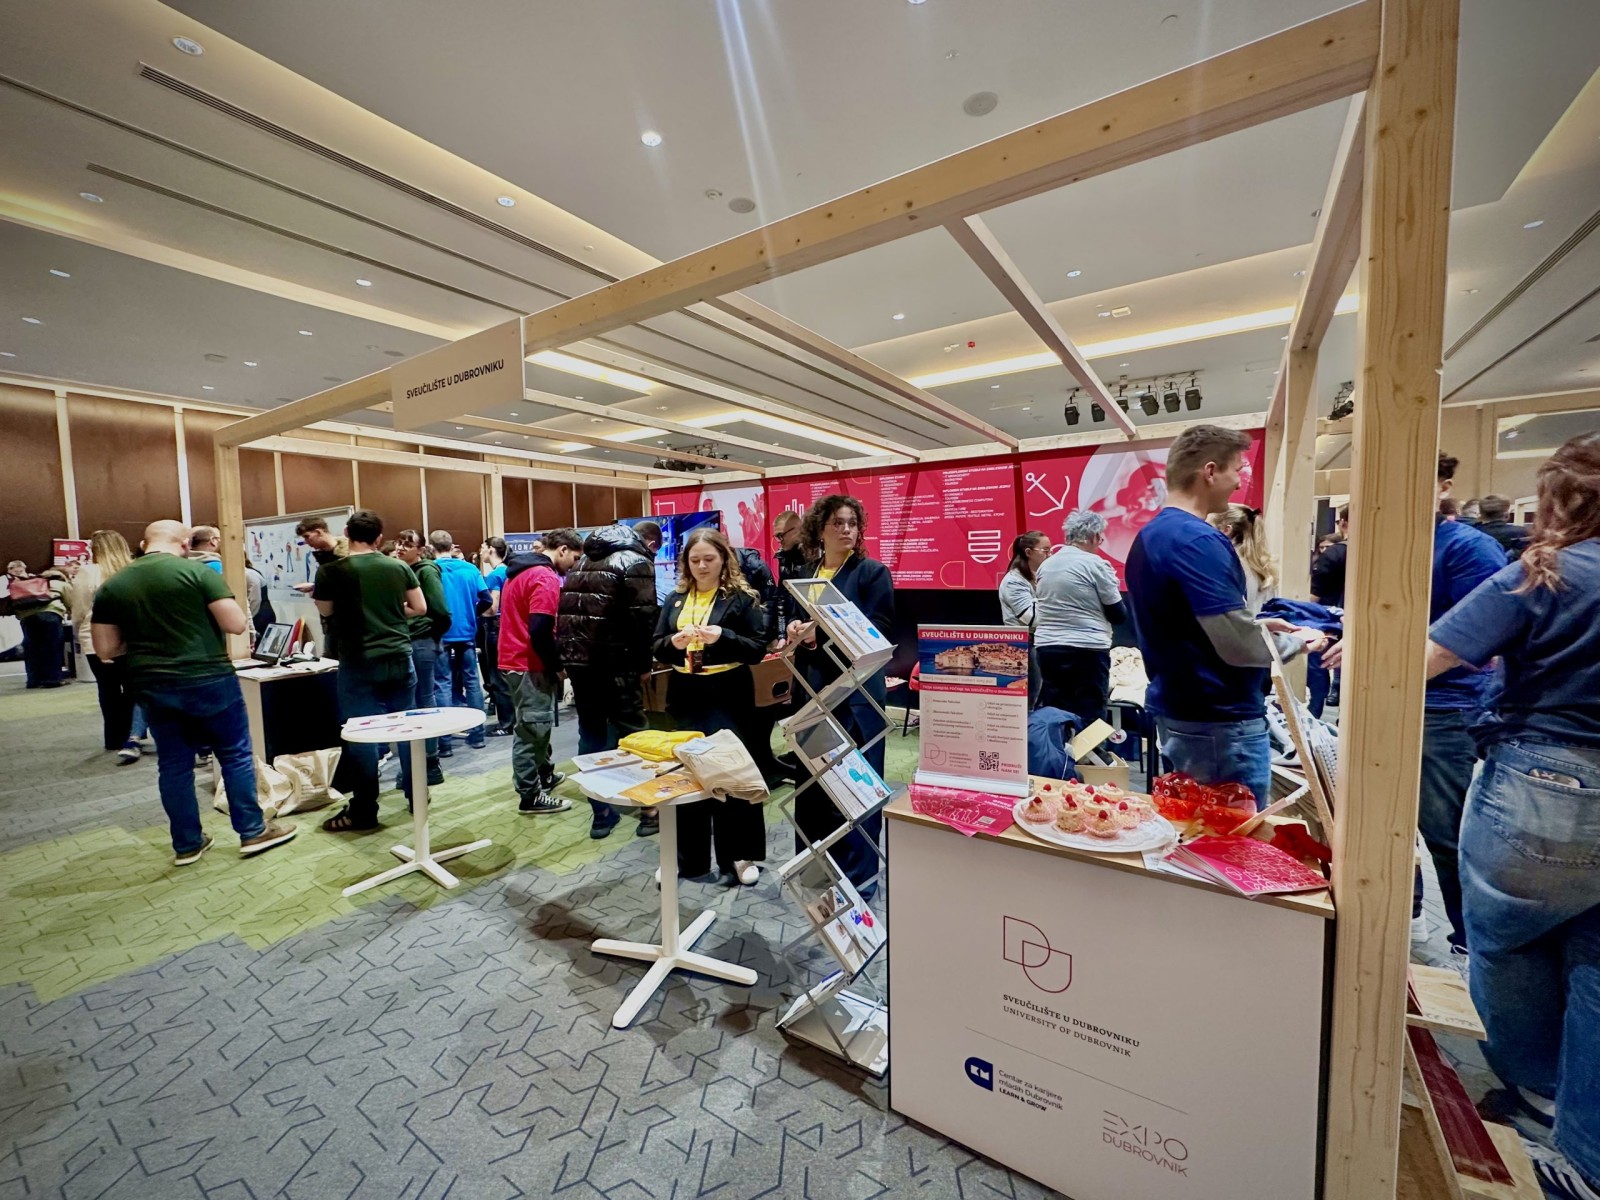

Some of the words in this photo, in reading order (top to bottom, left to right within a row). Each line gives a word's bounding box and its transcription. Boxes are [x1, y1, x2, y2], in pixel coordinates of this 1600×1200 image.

[406, 378, 446, 399] SVEUČILIŠTE
[447, 376, 452, 386] U
[454, 359, 504, 384] DUBROVNIKU
[922, 630, 964, 639] SVEUČILIŠTE
[973, 632, 1024, 641] DUBROVNIKU
[1003, 994, 1061, 1020] SVEUČILIŠTE
[1063, 1014, 1070, 1024] U
[1072, 1017, 1140, 1048] DUBROVNIKU
[1003, 1006, 1057, 1030] UNIVERSITY
[1059, 1024, 1072, 1036] OF
[1073, 1030, 1132, 1058] DUBROVNIK
[998, 1069, 1023, 1084] Centar
[1024, 1081, 1033, 1089] za
[1034, 1082, 1063, 1102] karijere
[998, 1078, 1024, 1094] mladih
[1024, 1088, 1064, 1111] Dubrovnik
[999, 1088, 1020, 1100] LEARN
[1026, 1098, 1047, 1112] GROW
[1102, 1132, 1188, 1177] DUBROVNIK
[1103, 1110, 1188, 1161] EXPO
